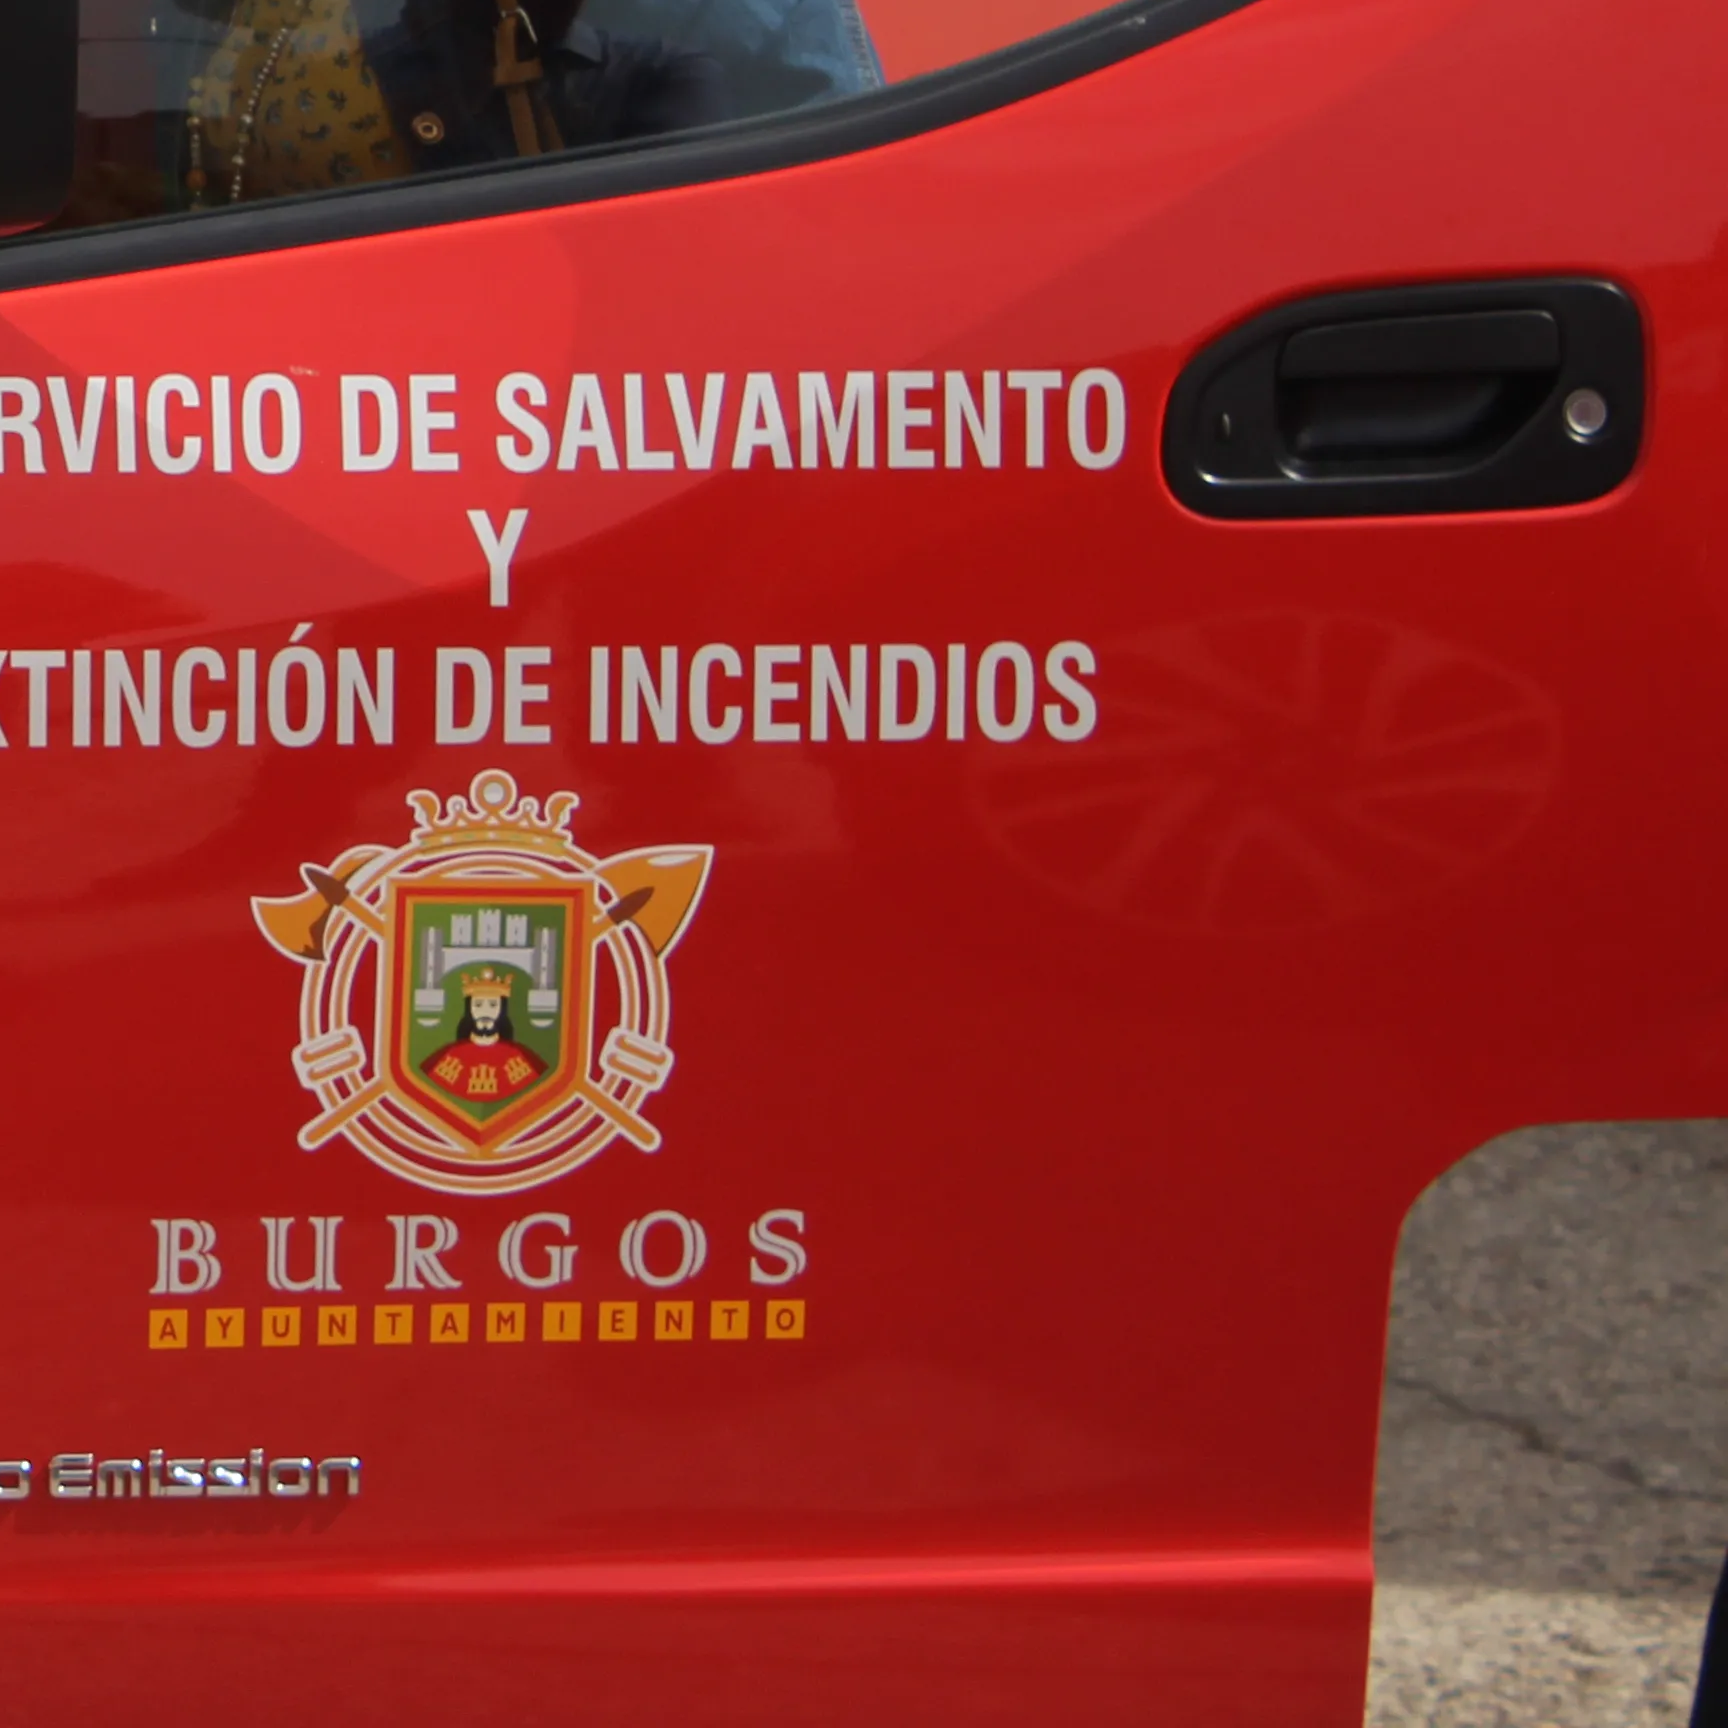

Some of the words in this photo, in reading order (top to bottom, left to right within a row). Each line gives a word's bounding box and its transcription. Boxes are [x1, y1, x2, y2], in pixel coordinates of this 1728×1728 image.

[339, 374, 460, 473] DE
[495, 368, 1126, 474] SALVAMENTO
[466, 508, 529, 607] Y
[435, 646, 551, 745] DE
[590, 641, 1097, 744] INCENDIOS
[148, 1209, 807, 1294] BURGOS
[155, 1304, 800, 1344] AYUNTAMIENTO
[48, 1447, 361, 1499] Emission
